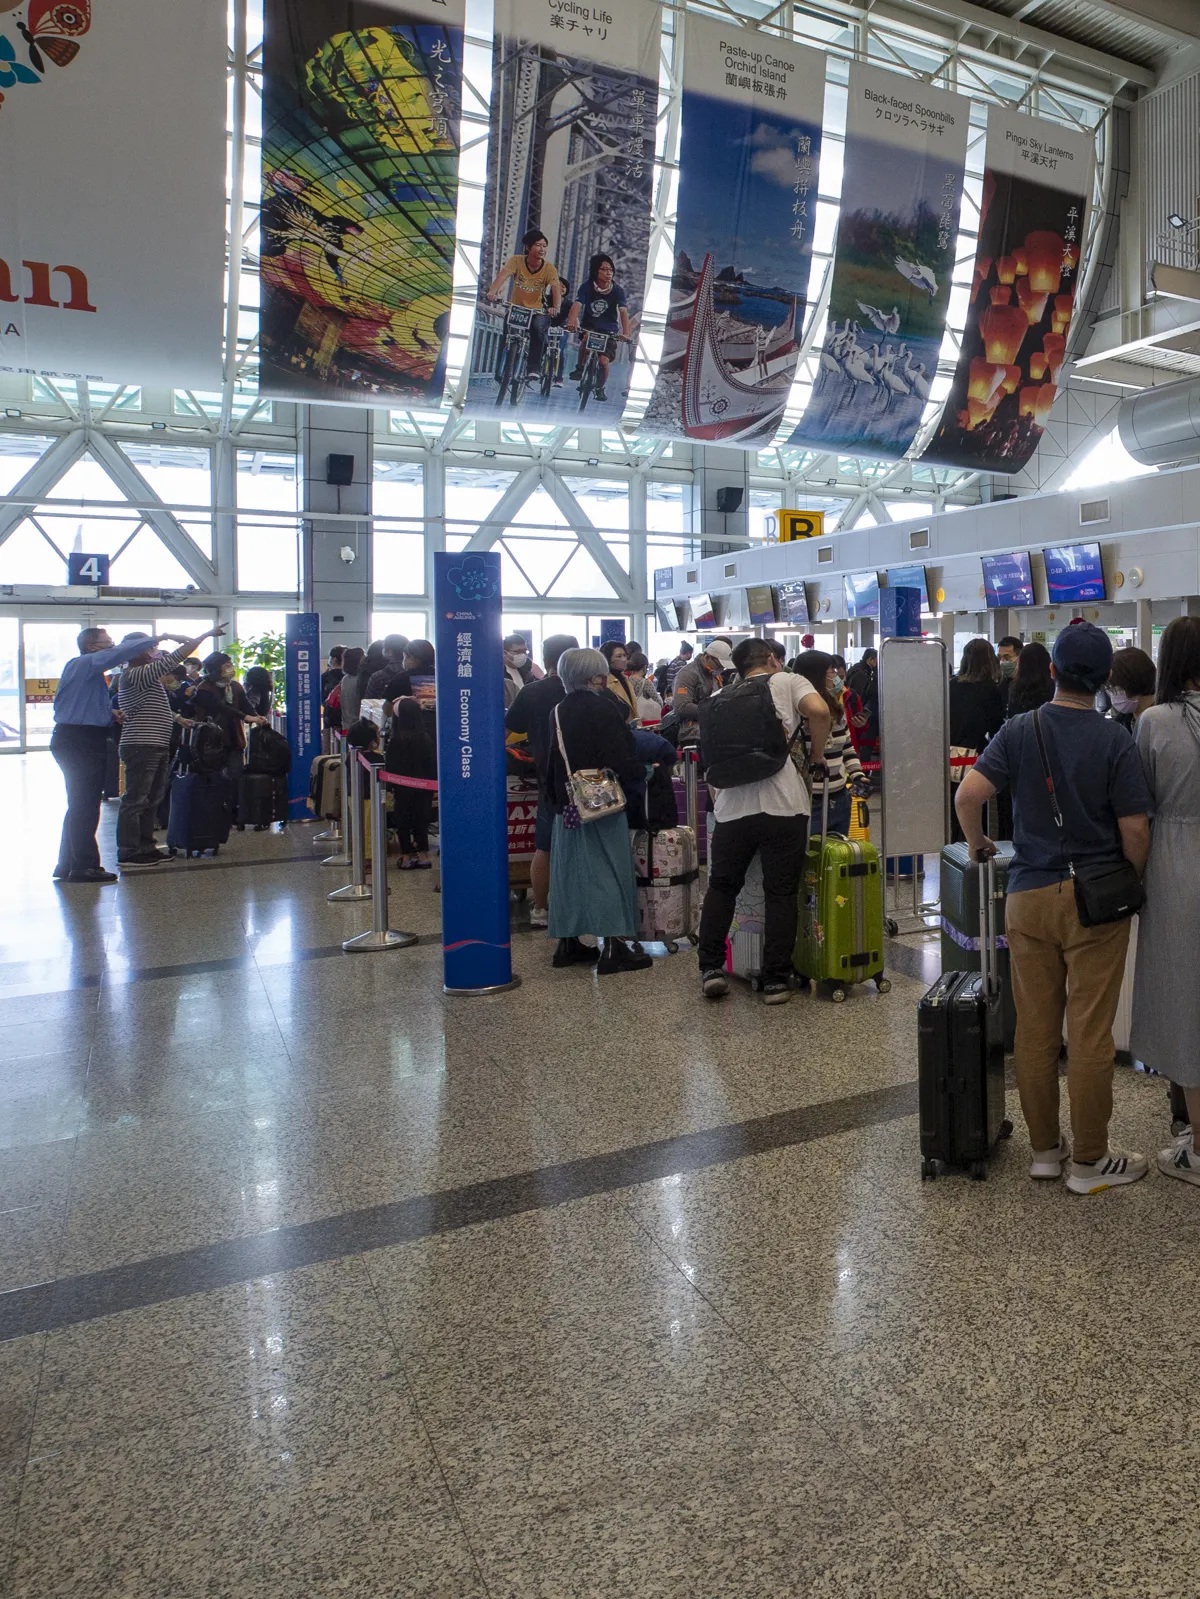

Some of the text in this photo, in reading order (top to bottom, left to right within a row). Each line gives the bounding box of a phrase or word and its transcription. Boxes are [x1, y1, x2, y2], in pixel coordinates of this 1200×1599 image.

[548, 0, 613, 24] Cycling Life
[550, 13, 608, 41] 楽チャリ
[719, 40, 795, 72] Paste-up Canoe
[725, 56, 787, 84] Orchid Island
[426, 39, 452, 139] 光之穹頂
[725, 72, 788, 101] 蘭嶼板張舟
[864, 88, 955, 126] Black-faced Spoonbills
[875, 107, 945, 137] クロツラヘラサギ
[625, 88, 647, 179] 單車漫活
[1005, 130, 1074, 161] Pingxi Sky Lanterns
[790, 135, 812, 240] 蘭嶼拼板舟
[510, 311, 529, 323] H104
[79, 557, 101, 582] 4
[456, 632, 473, 678] 經濟艙
[459, 689, 473, 779] Economy Class
